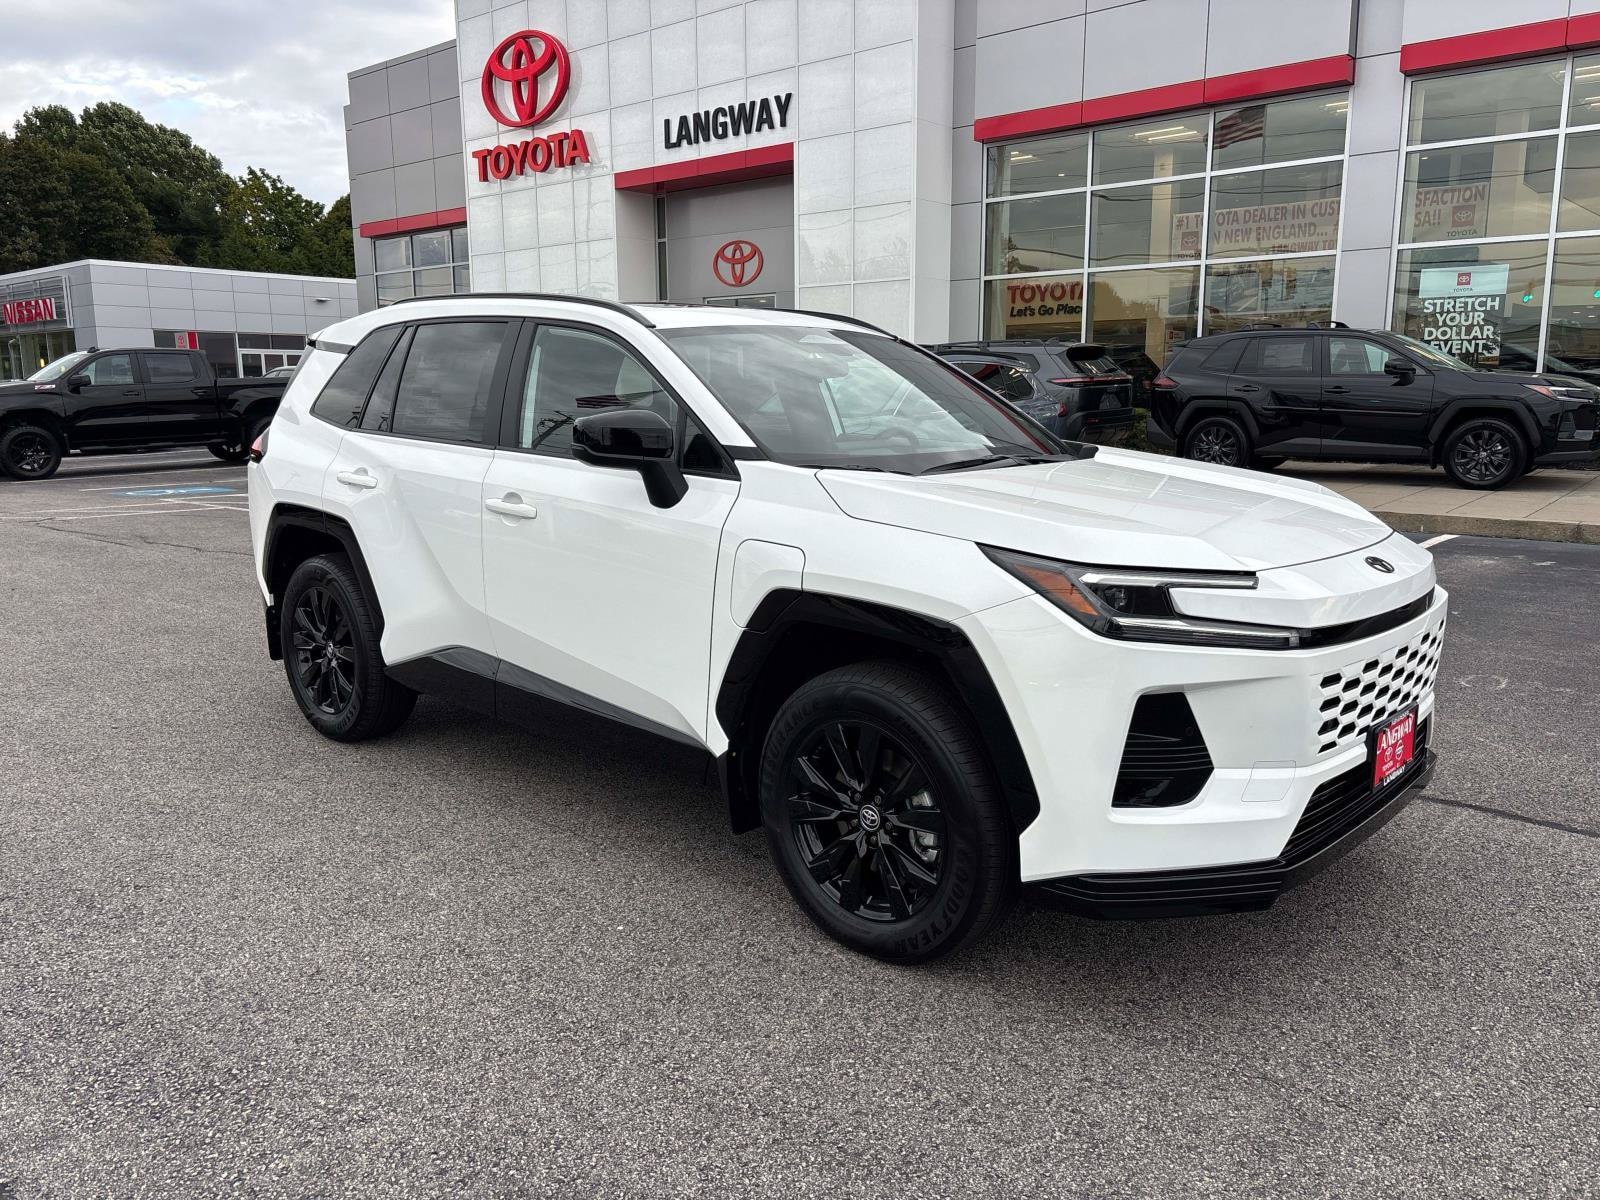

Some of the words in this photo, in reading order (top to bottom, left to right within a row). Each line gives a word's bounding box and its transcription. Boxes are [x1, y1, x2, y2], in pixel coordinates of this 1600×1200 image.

[664, 93, 793, 149] LANGWAY
[472, 129, 590, 182] TOYOTA
[1176, 215, 1190, 230] #1
[1194, 208, 1240, 229] TOTA
[1243, 205, 1288, 225] DEALER
[1291, 204, 1306, 220] IN
[1224, 227, 1252, 245] NEW
[1255, 222, 1328, 242] ENGLAND...
[1446, 228, 1477, 237] TOYOTA
[3, 297, 56, 325] NISSAN
[1010, 304, 1036, 318] Let's
[1037, 303, 1055, 316] Go
[1423, 296, 1499, 313] STRETCH
[1435, 311, 1485, 326] YOUR
[1423, 325, 1495, 341] DOLLAR
[1429, 339, 1486, 354] EVENT
[1376, 713, 1414, 755] LANGWAY
